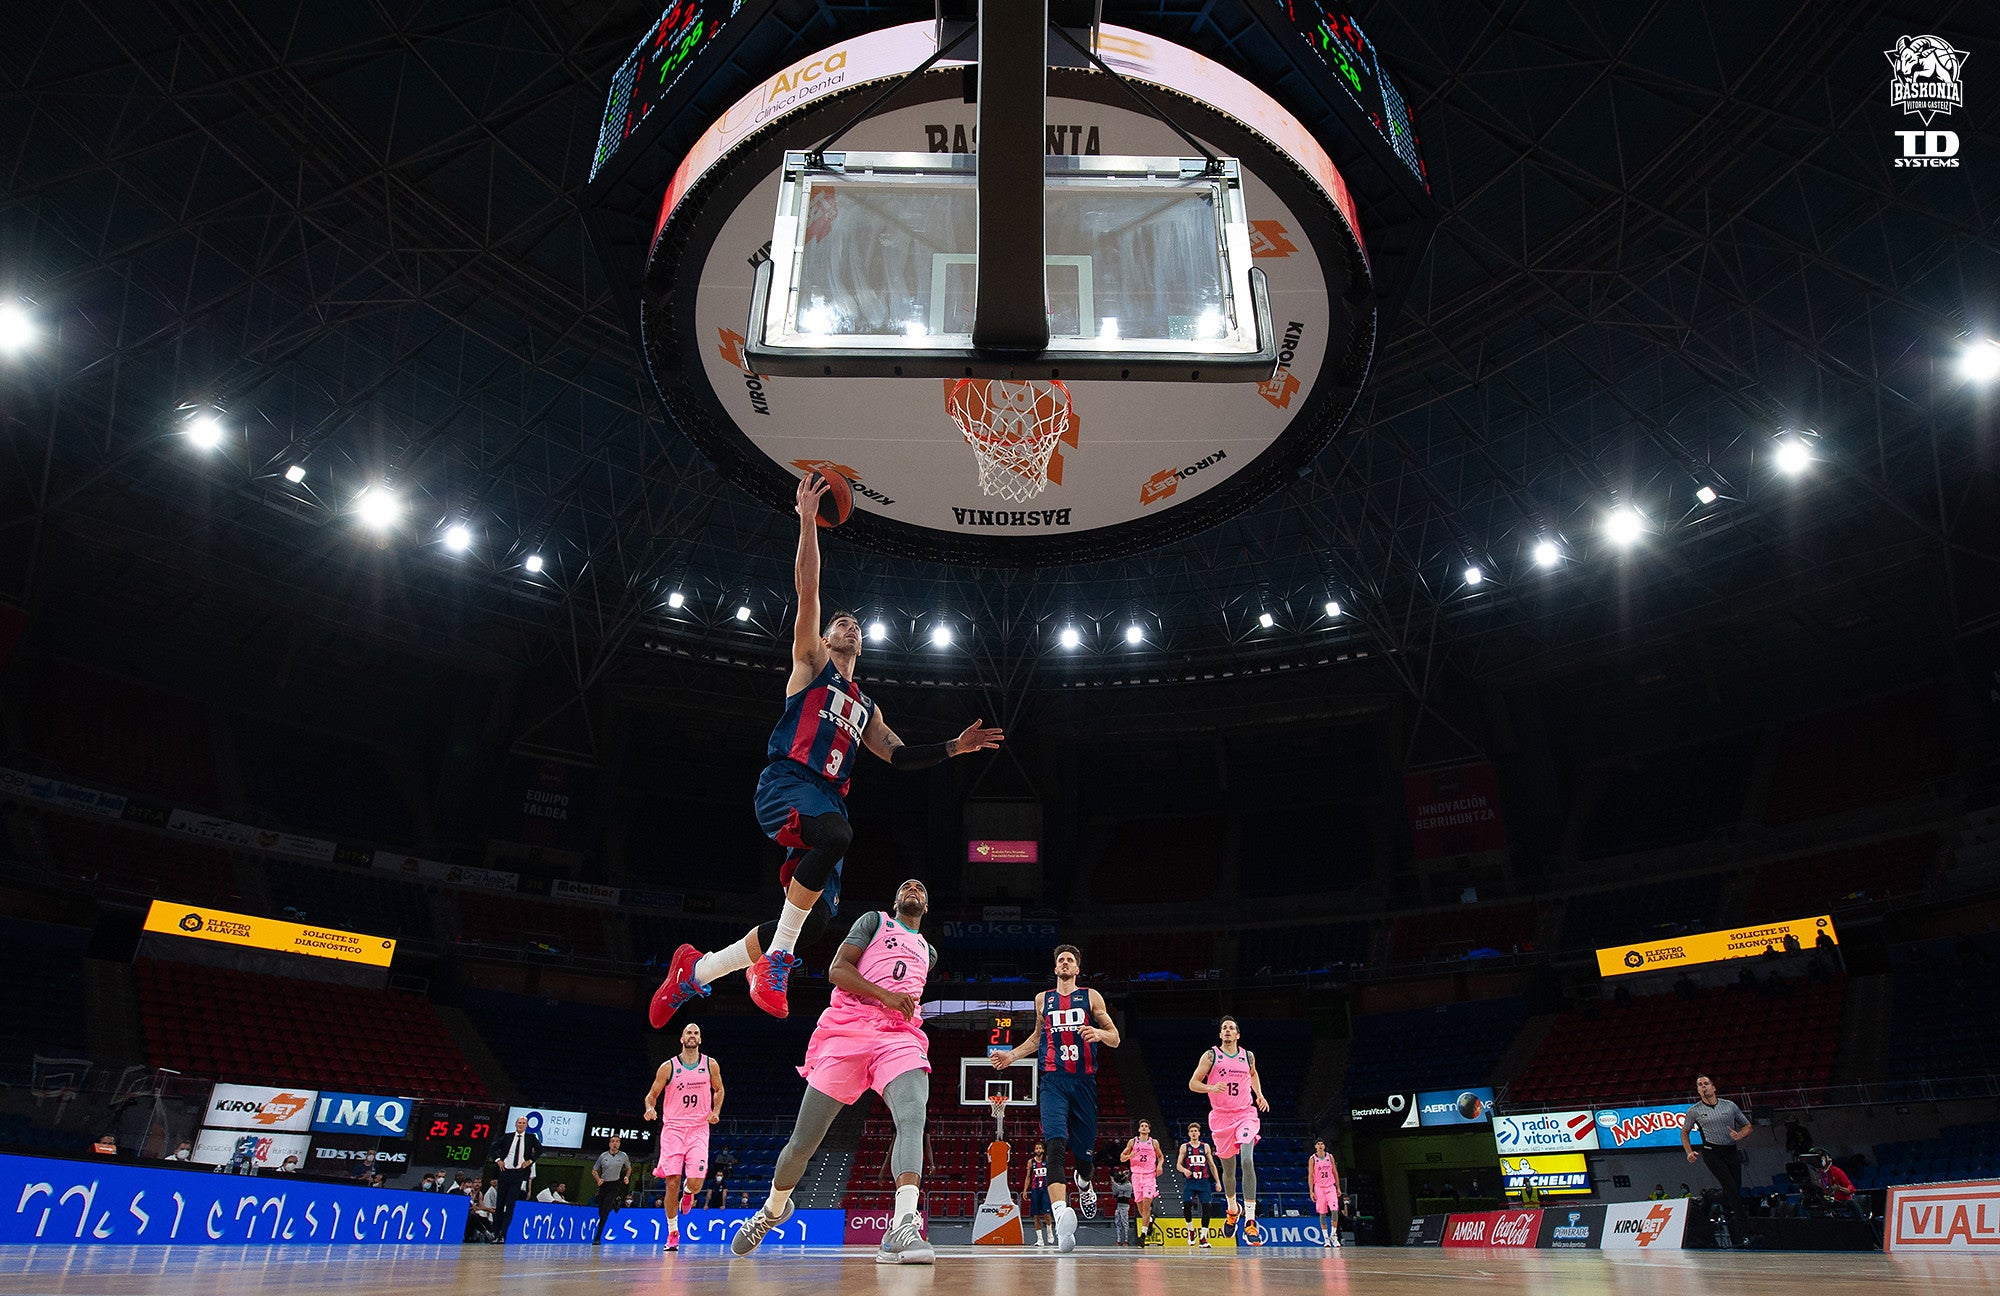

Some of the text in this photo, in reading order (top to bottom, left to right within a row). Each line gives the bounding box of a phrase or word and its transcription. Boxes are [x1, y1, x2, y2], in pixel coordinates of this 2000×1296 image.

[660, 21, 703, 84] 7:28
[1317, 25, 1361, 91] 7:28
[768, 50, 847, 103] Arca
[799, 72, 845, 98] Dental
[952, 507, 1072, 526] BASKONIA
[827, 684, 869, 737] TD
[826, 749, 843, 776] 3
[206, 926, 250, 937] ALAVESA
[207, 919, 251, 931] ELECTRO
[303, 929, 348, 943] SOLICITE
[1730, 928, 1777, 940] SOLICITE
[294, 938, 362, 954] DIAGNÓSTICO
[1727, 935, 1799, 950] DIAGNÓSTIO
[1645, 946, 1683, 957] ELECTRO
[1647, 952, 1686, 963] ALAVESA
[893, 960, 907, 981] 0
[995, 1018, 1012, 1027] 7:28
[1048, 1008, 1085, 1027] TD
[991, 1029, 1010, 1044] 21
[1060, 1044, 1079, 1061] 33
[1227, 1082, 1239, 1096] 13
[683, 1094, 698, 1108] 99
[316, 1098, 405, 1133] IMQ
[430, 1121, 490, 1138] 25 2 27
[1522, 1116, 1559, 1131] radio
[1612, 1112, 1692, 1145] MAXIBO
[1524, 1130, 1572, 1145] vitoria
[446, 1145, 472, 1160] 7:28
[1188, 1155, 1206, 1164] TD
[1614, 1218, 1664, 1233] KIROLBET
[1910, 1203, 2000, 1234] VIAL
[1268, 1227, 1325, 1245] IMQ
[1452, 1221, 1486, 1240] AMBAR
[1554, 1227, 1590, 1238] POWERADE
